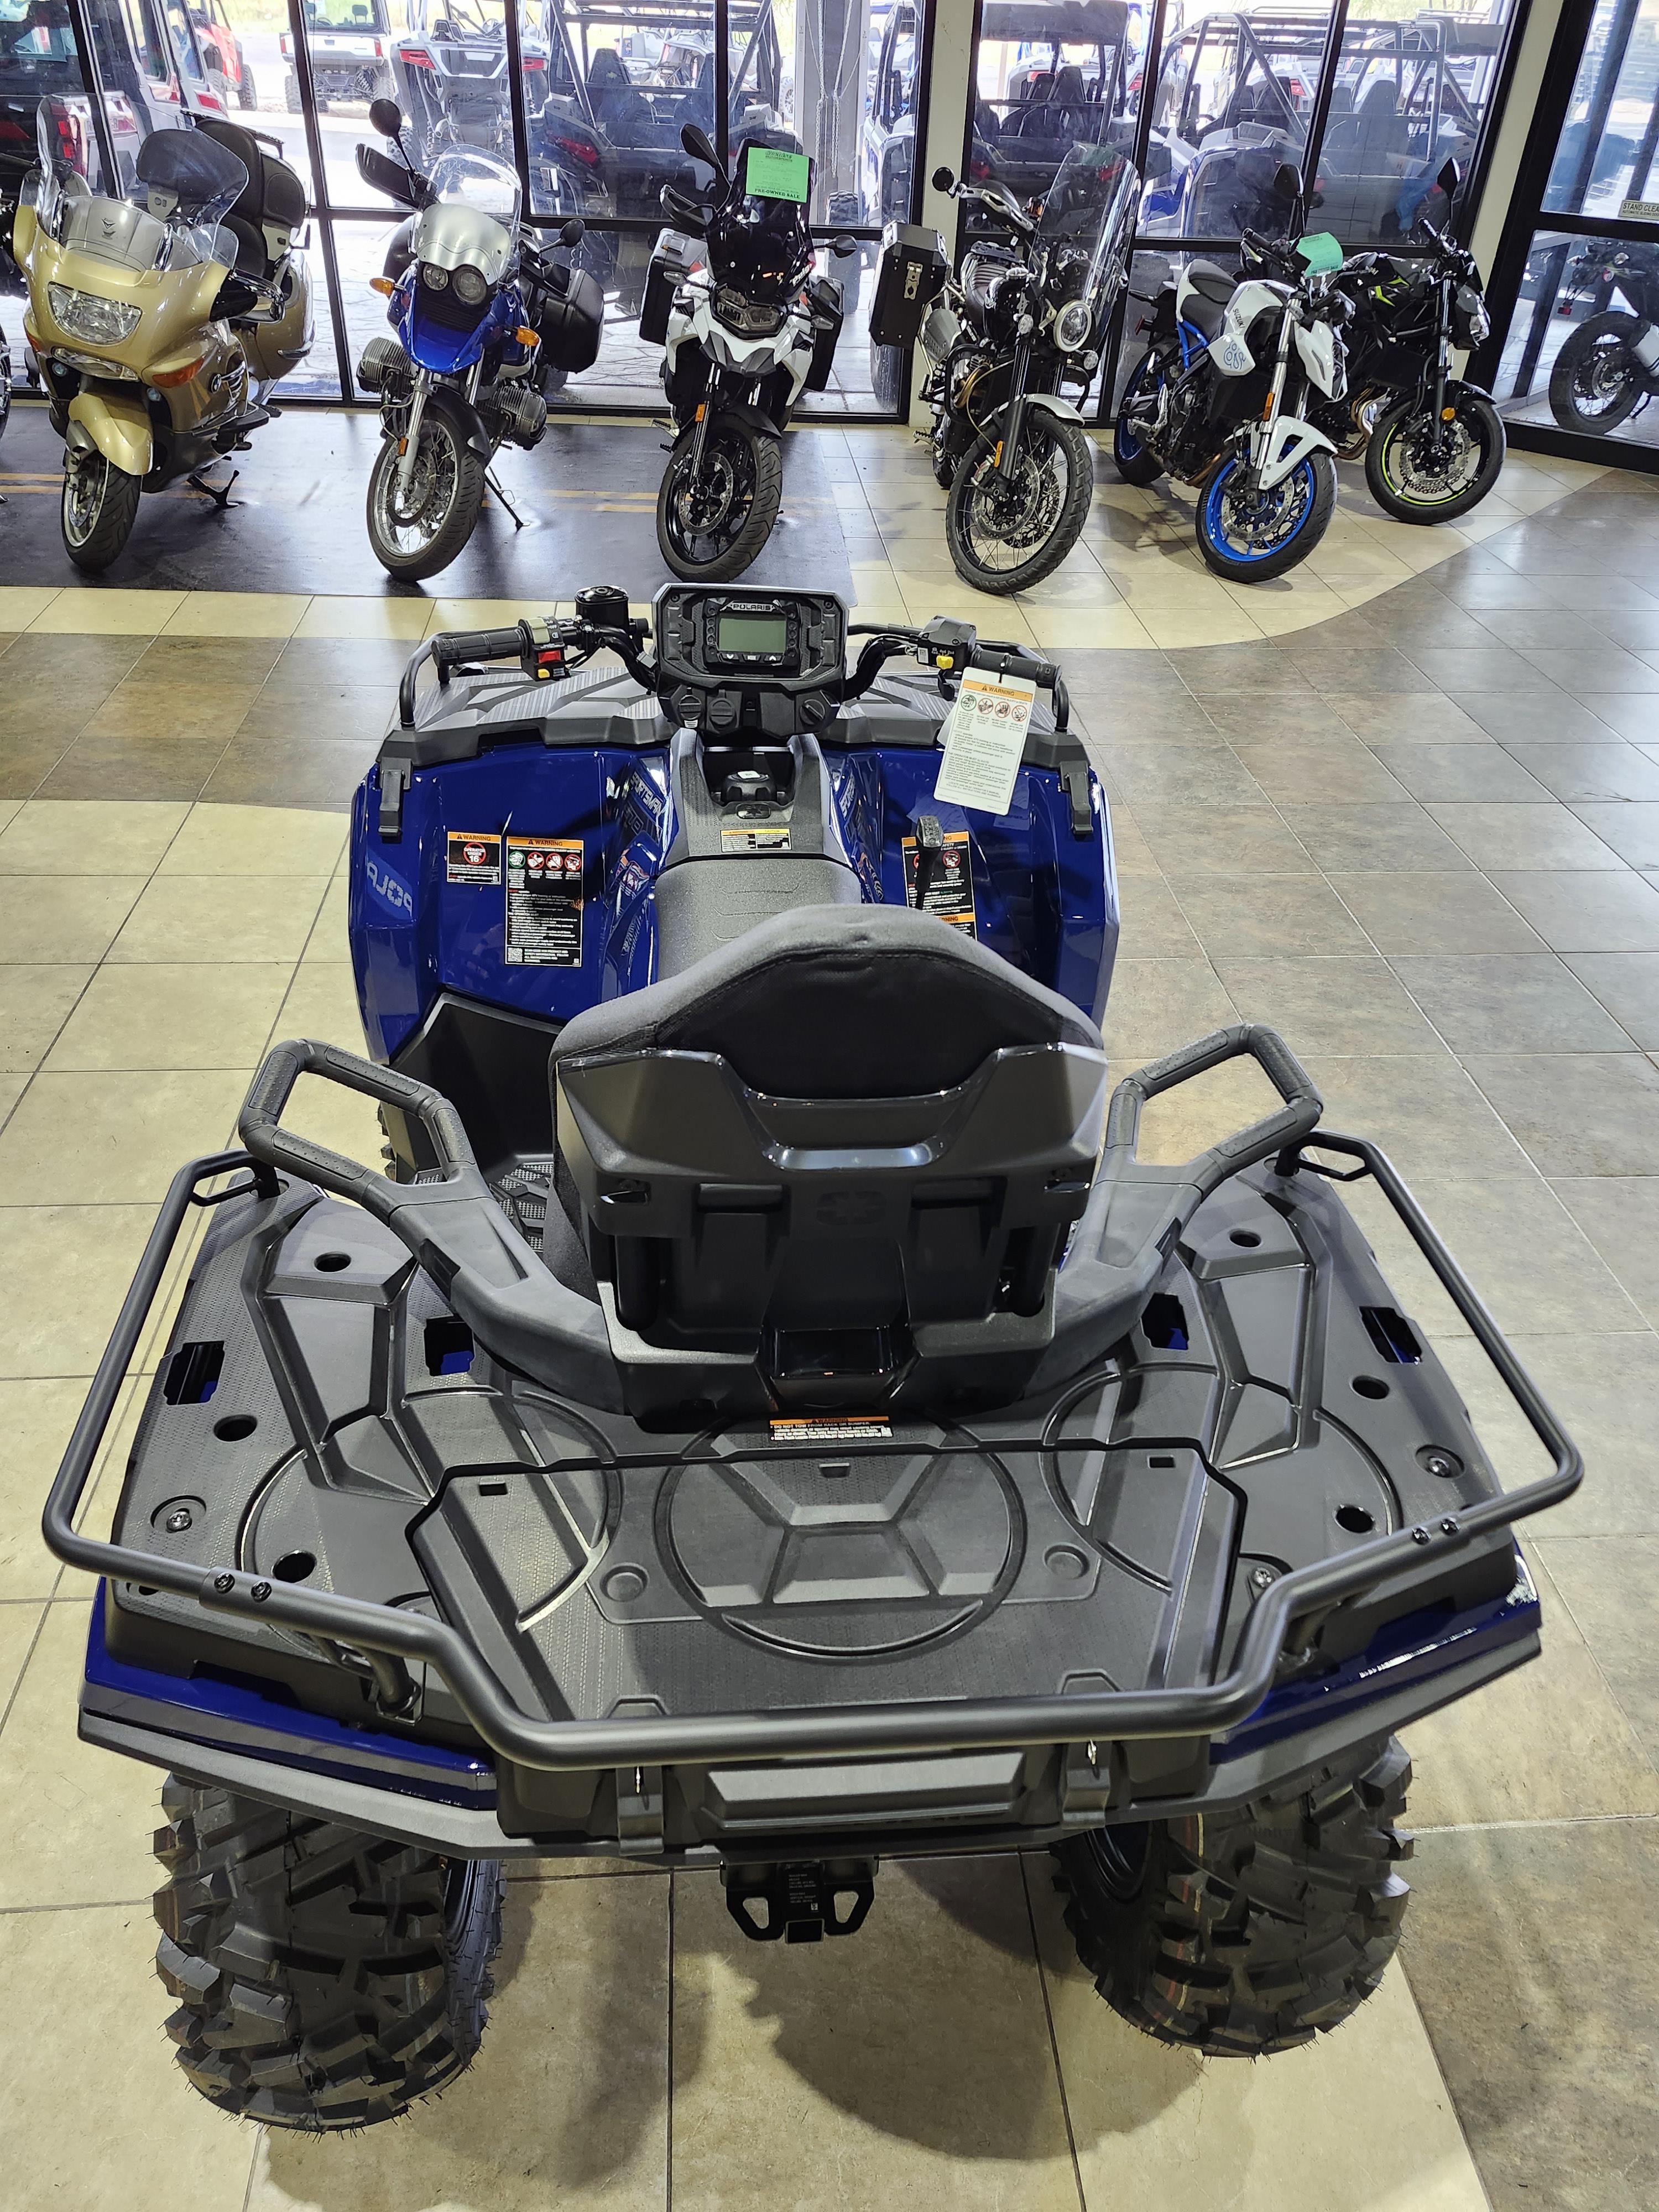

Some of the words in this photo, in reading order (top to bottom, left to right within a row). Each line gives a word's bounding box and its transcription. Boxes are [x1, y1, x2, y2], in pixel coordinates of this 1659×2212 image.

[755, 188, 786, 196] PRE-OWNED
[1623, 202, 1643, 211] STAND
[1233, 307, 1245, 329] SUZUKI
[988, 686, 1015, 696] WARNING
[630, 770, 663, 815] SPORTSMAN
